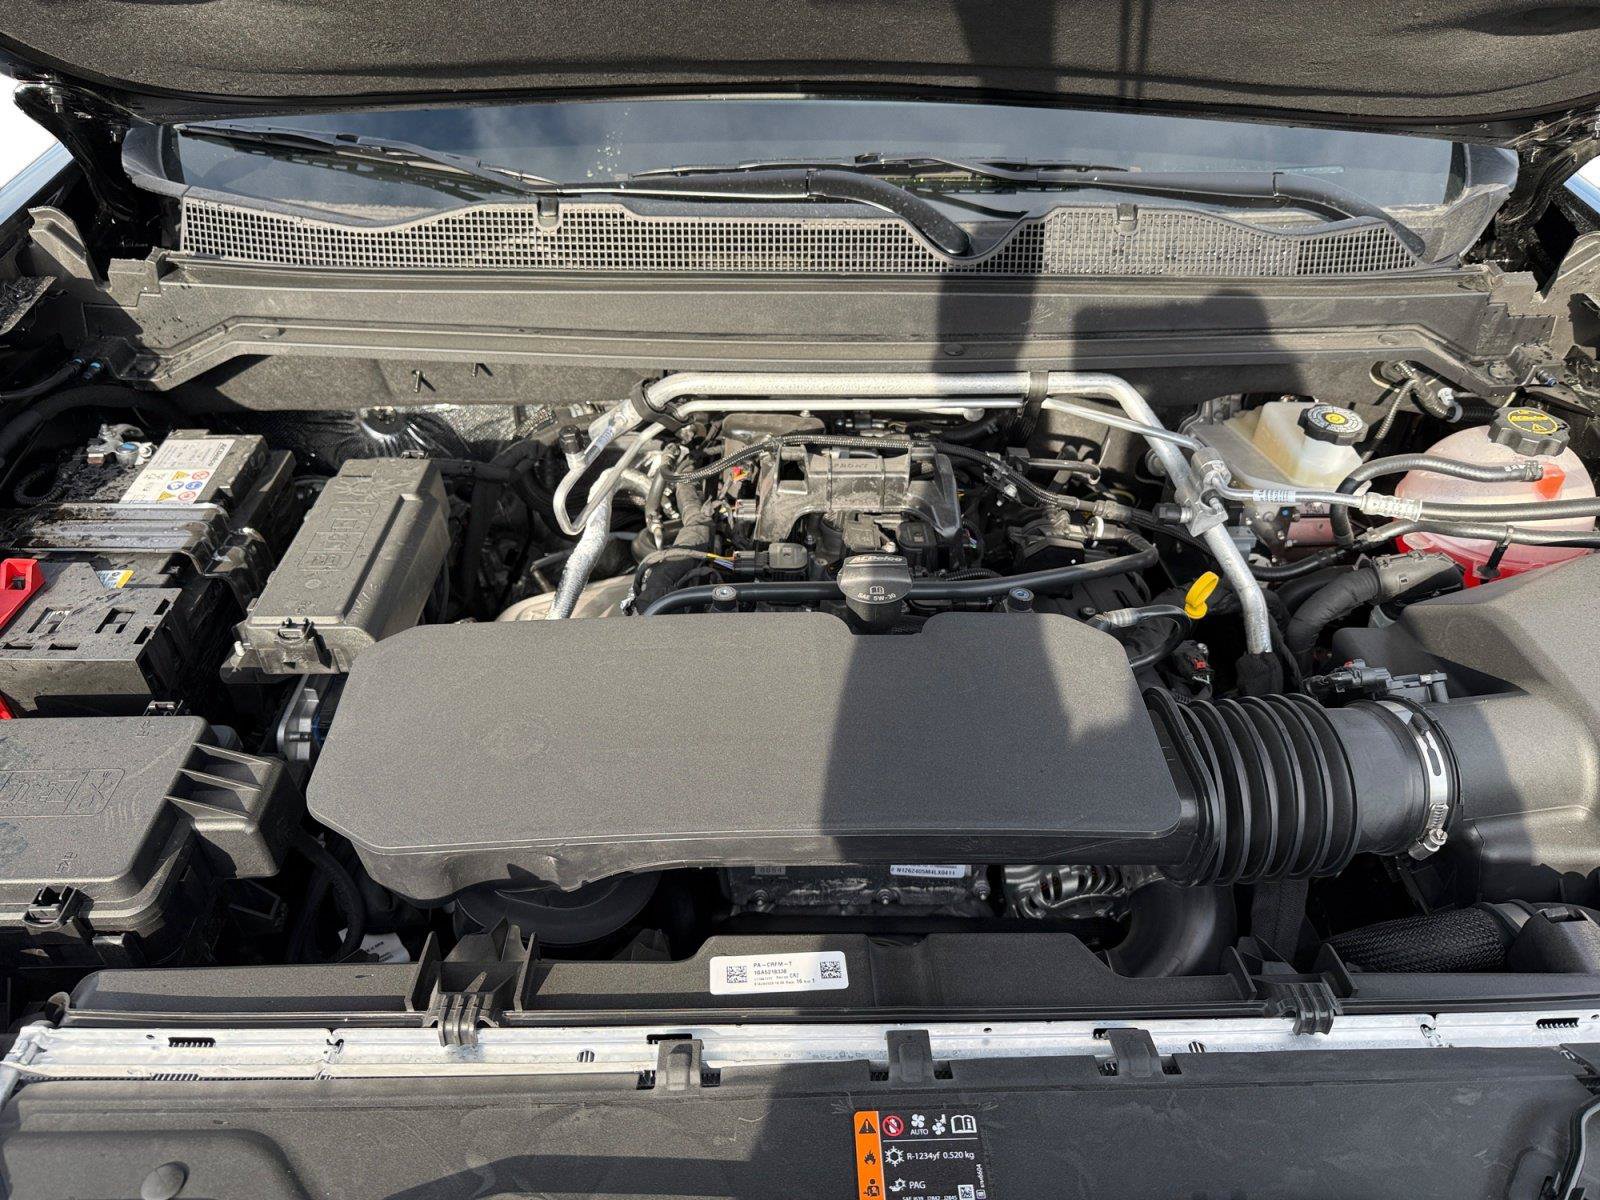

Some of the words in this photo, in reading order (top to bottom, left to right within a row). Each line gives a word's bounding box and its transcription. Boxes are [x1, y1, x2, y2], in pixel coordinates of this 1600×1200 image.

[849, 555, 903, 563] ACDelco
[858, 592, 871, 601] SAE
[873, 593, 897, 602] 5W-30
[910, 1128, 929, 1136] AUTO
[906, 1151, 941, 1161] R-1234yf
[942, 1151, 964, 1159] 0.520
[964, 1150, 975, 1160] kg
[909, 1180, 926, 1189] PAG
